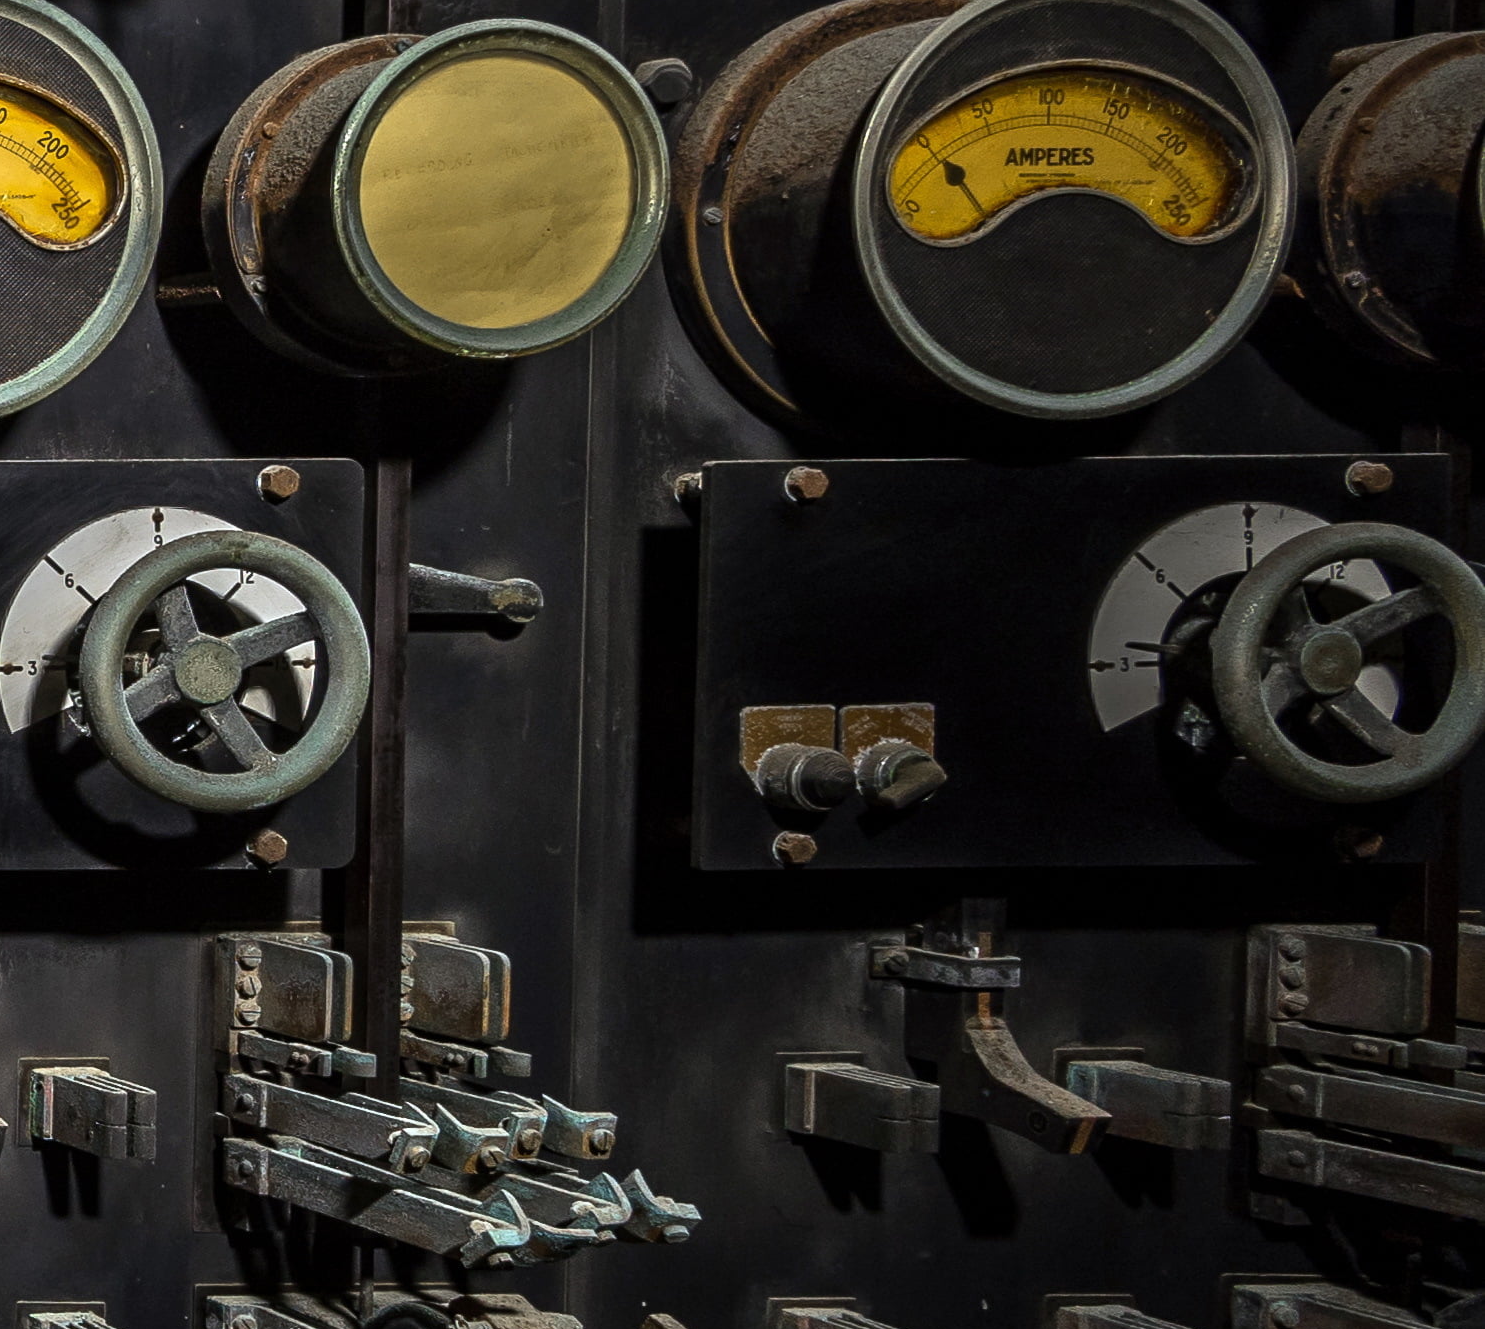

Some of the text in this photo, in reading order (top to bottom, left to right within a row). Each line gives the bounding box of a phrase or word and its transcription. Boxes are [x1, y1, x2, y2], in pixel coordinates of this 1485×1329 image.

[1039, 88, 1065, 106] 100
[971, 97, 994, 119] 50
[1101, 97, 1130, 121] 150
[37, 129, 70, 161] 200
[915, 133, 930, 150] 0
[1156, 125, 1188, 157] 200
[1004, 147, 1095, 167] AMPERES
[49, 197, 80, 230] 250
[1161, 194, 1191, 227] 250
[153, 535, 163, 549] 9
[1244, 530, 1254, 546] 9
[240, 570, 255, 585] 12
[1155, 569, 1166, 585] 6
[1329, 563, 1345, 579] 12
[64, 572, 75, 588] 6
[27, 660, 38, 676] 3
[1119, 657, 1130, 673] 3
